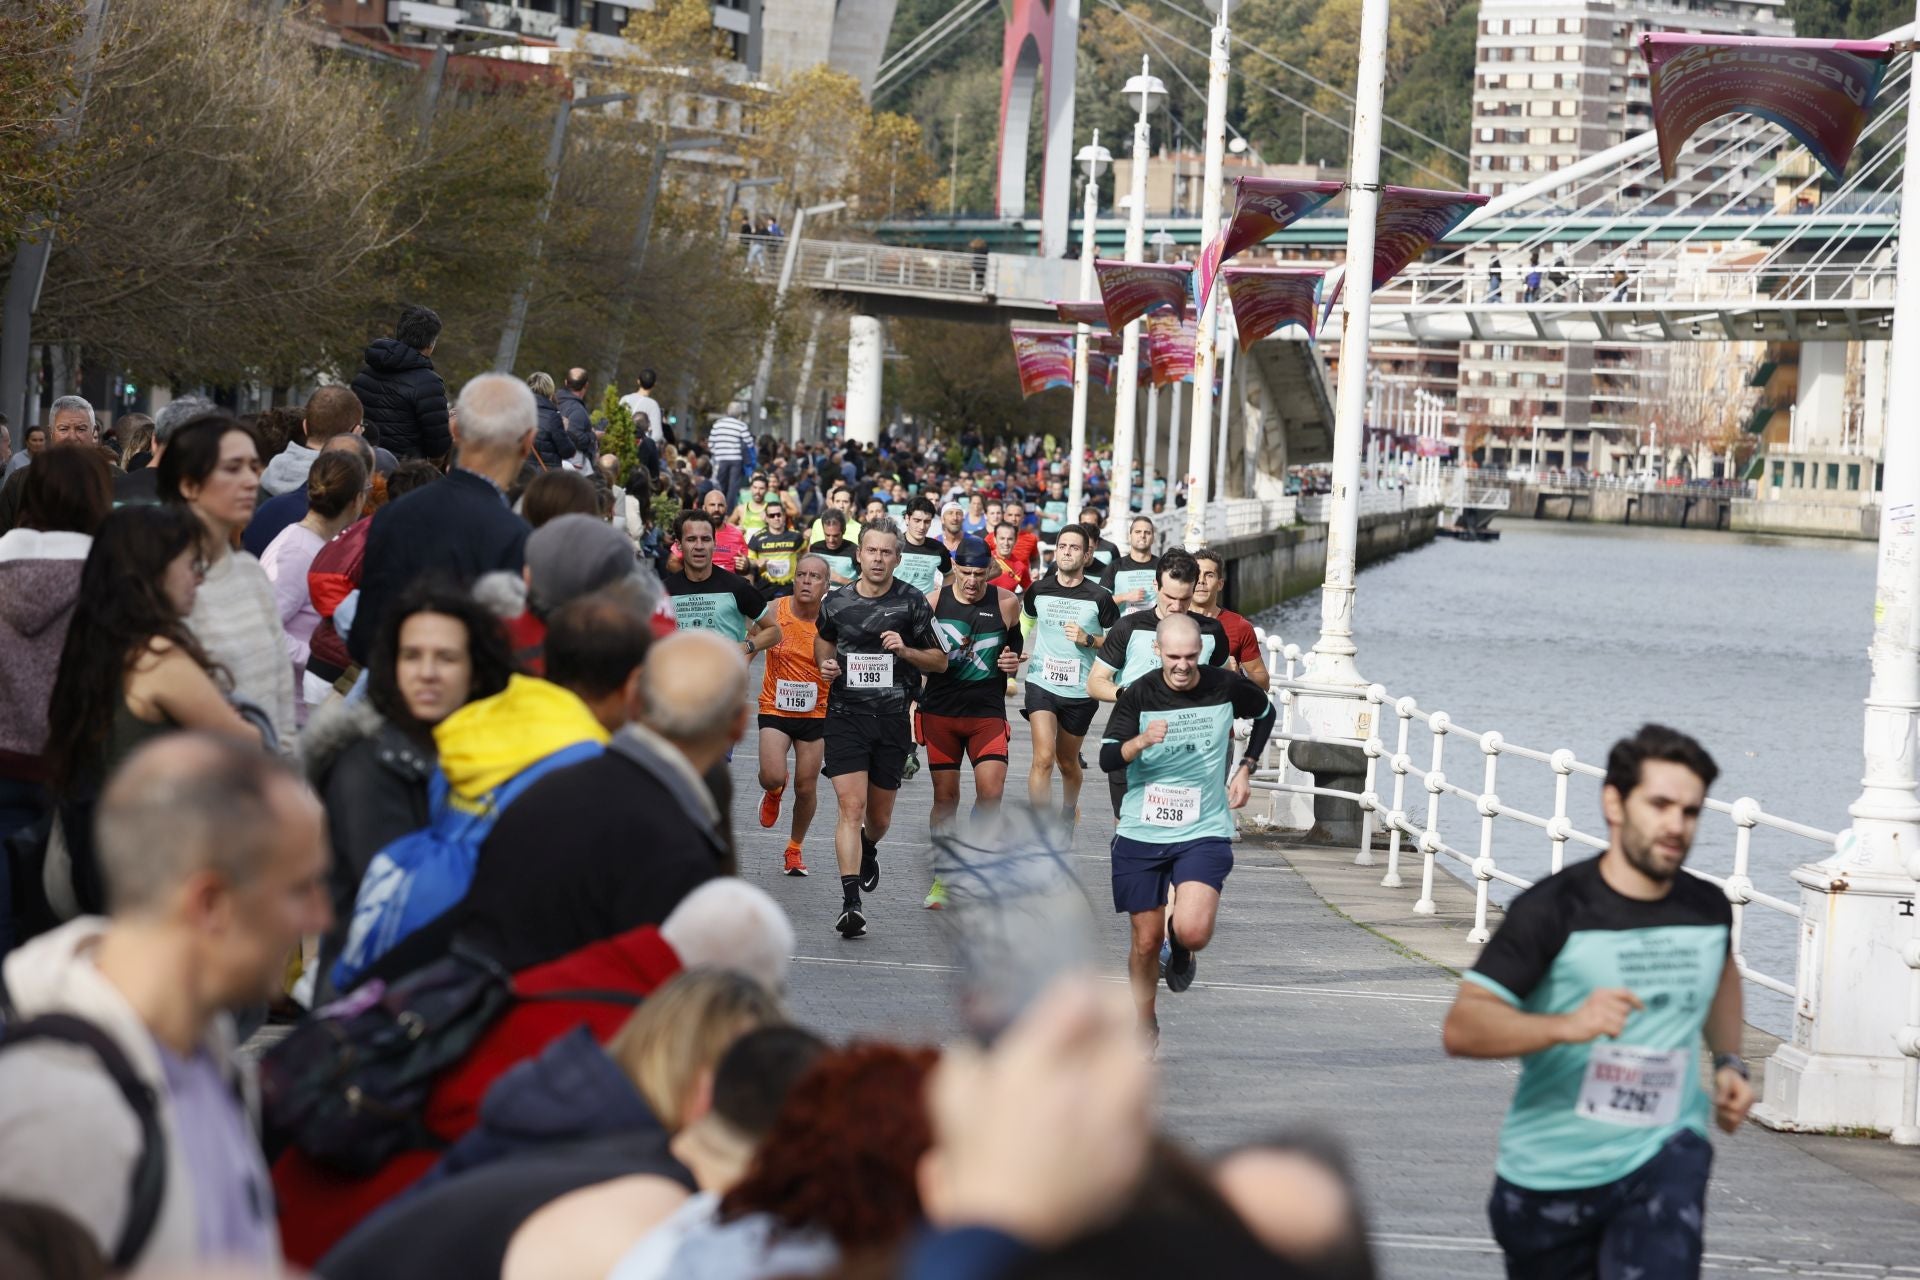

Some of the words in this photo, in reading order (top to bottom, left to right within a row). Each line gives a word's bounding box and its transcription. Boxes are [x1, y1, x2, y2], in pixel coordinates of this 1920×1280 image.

[1660, 50, 1867, 106] Saturday
[859, 672, 880, 682] 1393
[1050, 672, 1068, 682] 2794
[786, 697, 806, 708] 1156
[1148, 793, 1168, 806] XXXVI
[1156, 807, 1183, 821] 2538
